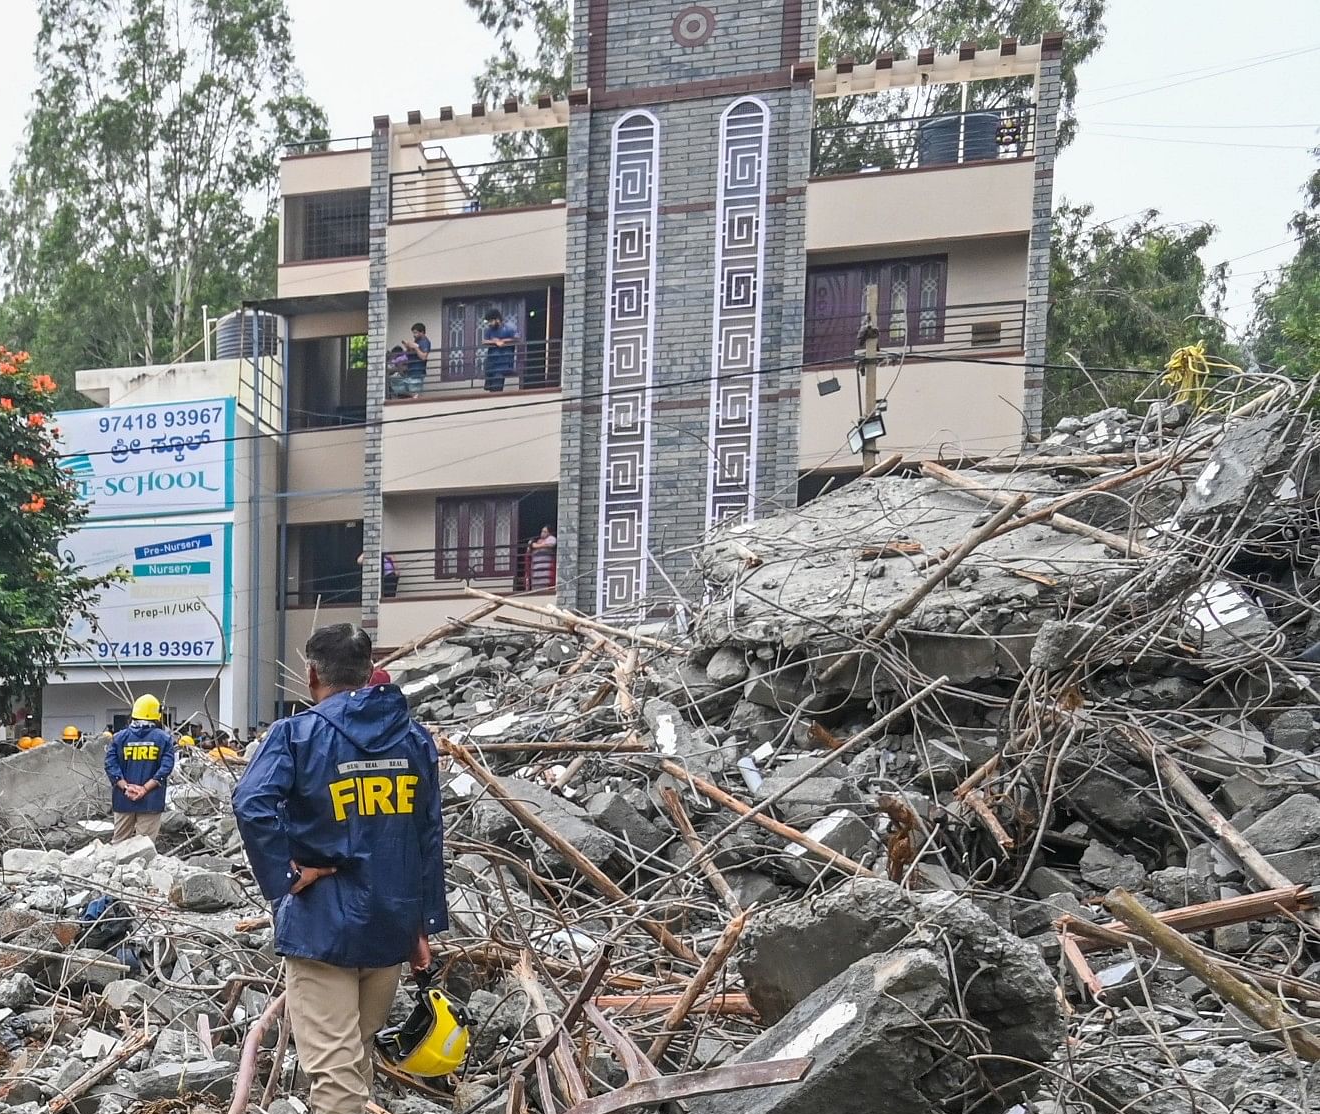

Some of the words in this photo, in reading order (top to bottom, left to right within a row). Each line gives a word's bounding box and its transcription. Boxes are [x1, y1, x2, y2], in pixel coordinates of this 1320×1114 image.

[99, 413, 157, 433] 97418
[164, 407, 222, 428] 93967
[143, 538, 201, 557] Pre-Nursery
[148, 564, 192, 575] Nursery
[98, 641, 153, 657] 97418
[159, 641, 215, 657] 93967
[123, 746, 159, 761] FIRE
[329, 775, 419, 822] FIRE
